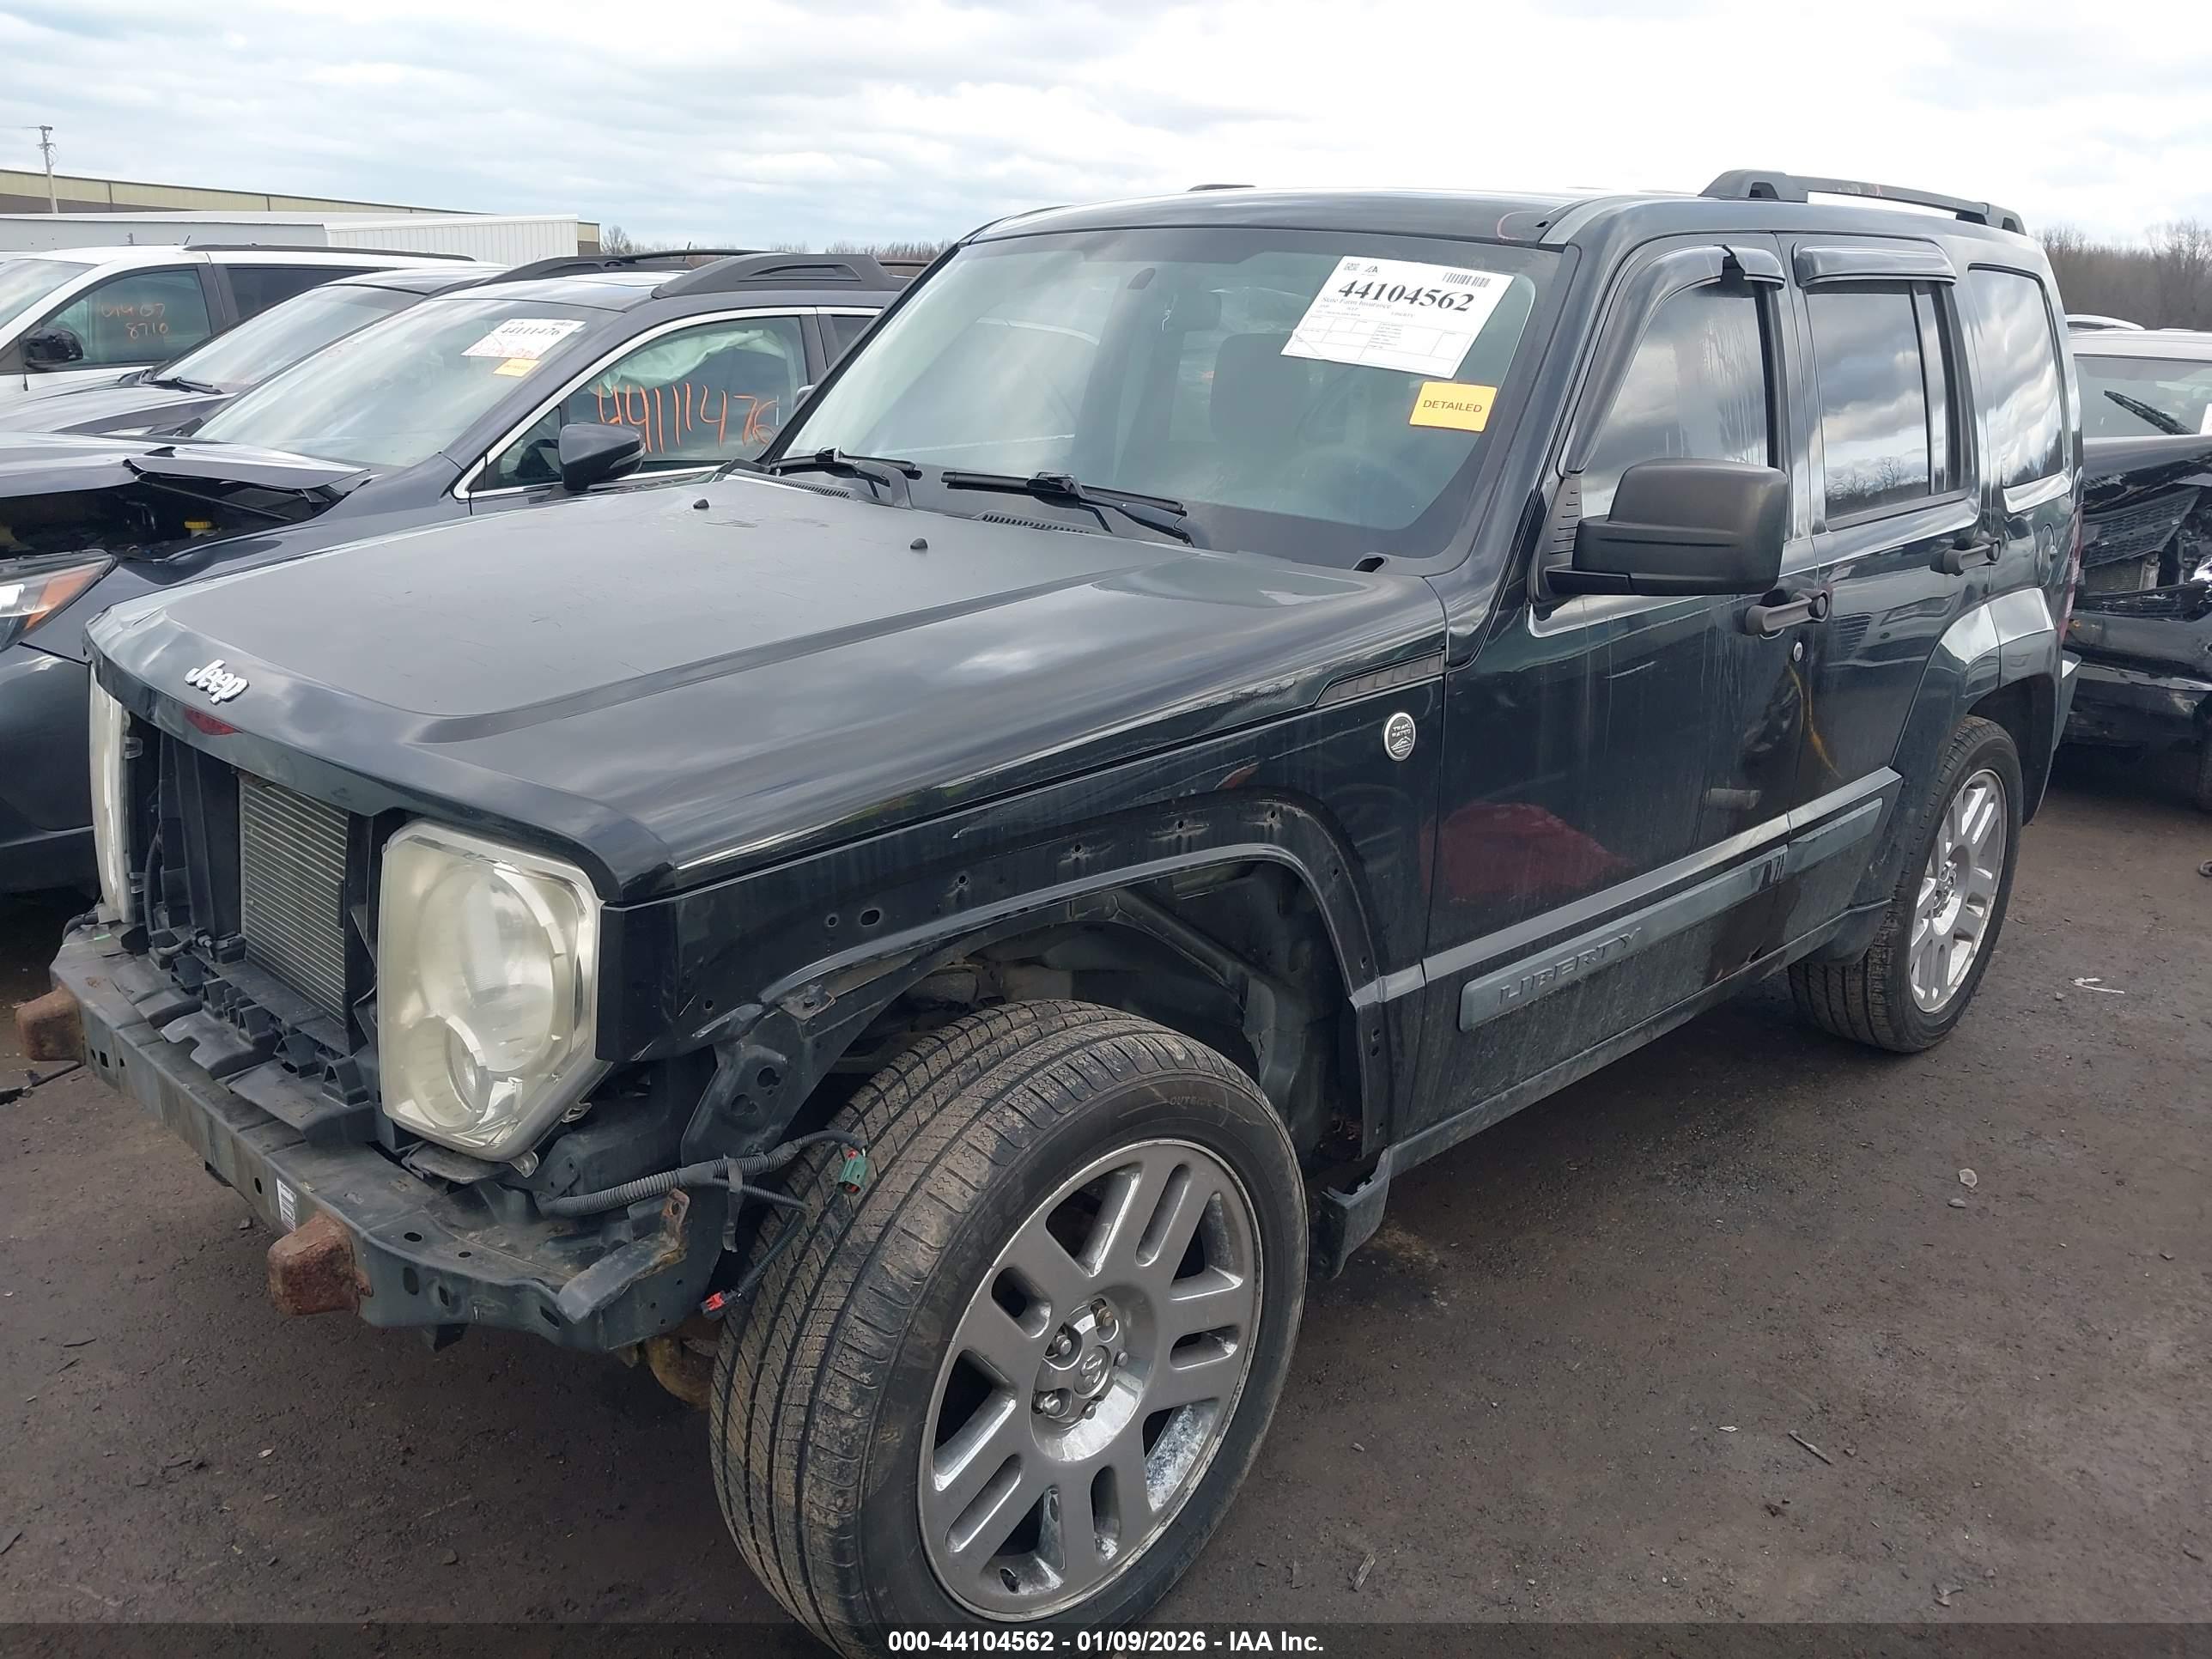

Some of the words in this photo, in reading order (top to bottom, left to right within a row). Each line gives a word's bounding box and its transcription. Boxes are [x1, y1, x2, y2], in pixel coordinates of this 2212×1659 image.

[1338, 280, 1474, 312] 44104562
[1423, 399, 1483, 413] DETAILED
[185, 659, 250, 706] Jeep
[1498, 927, 1642, 1005] LIBERTY
